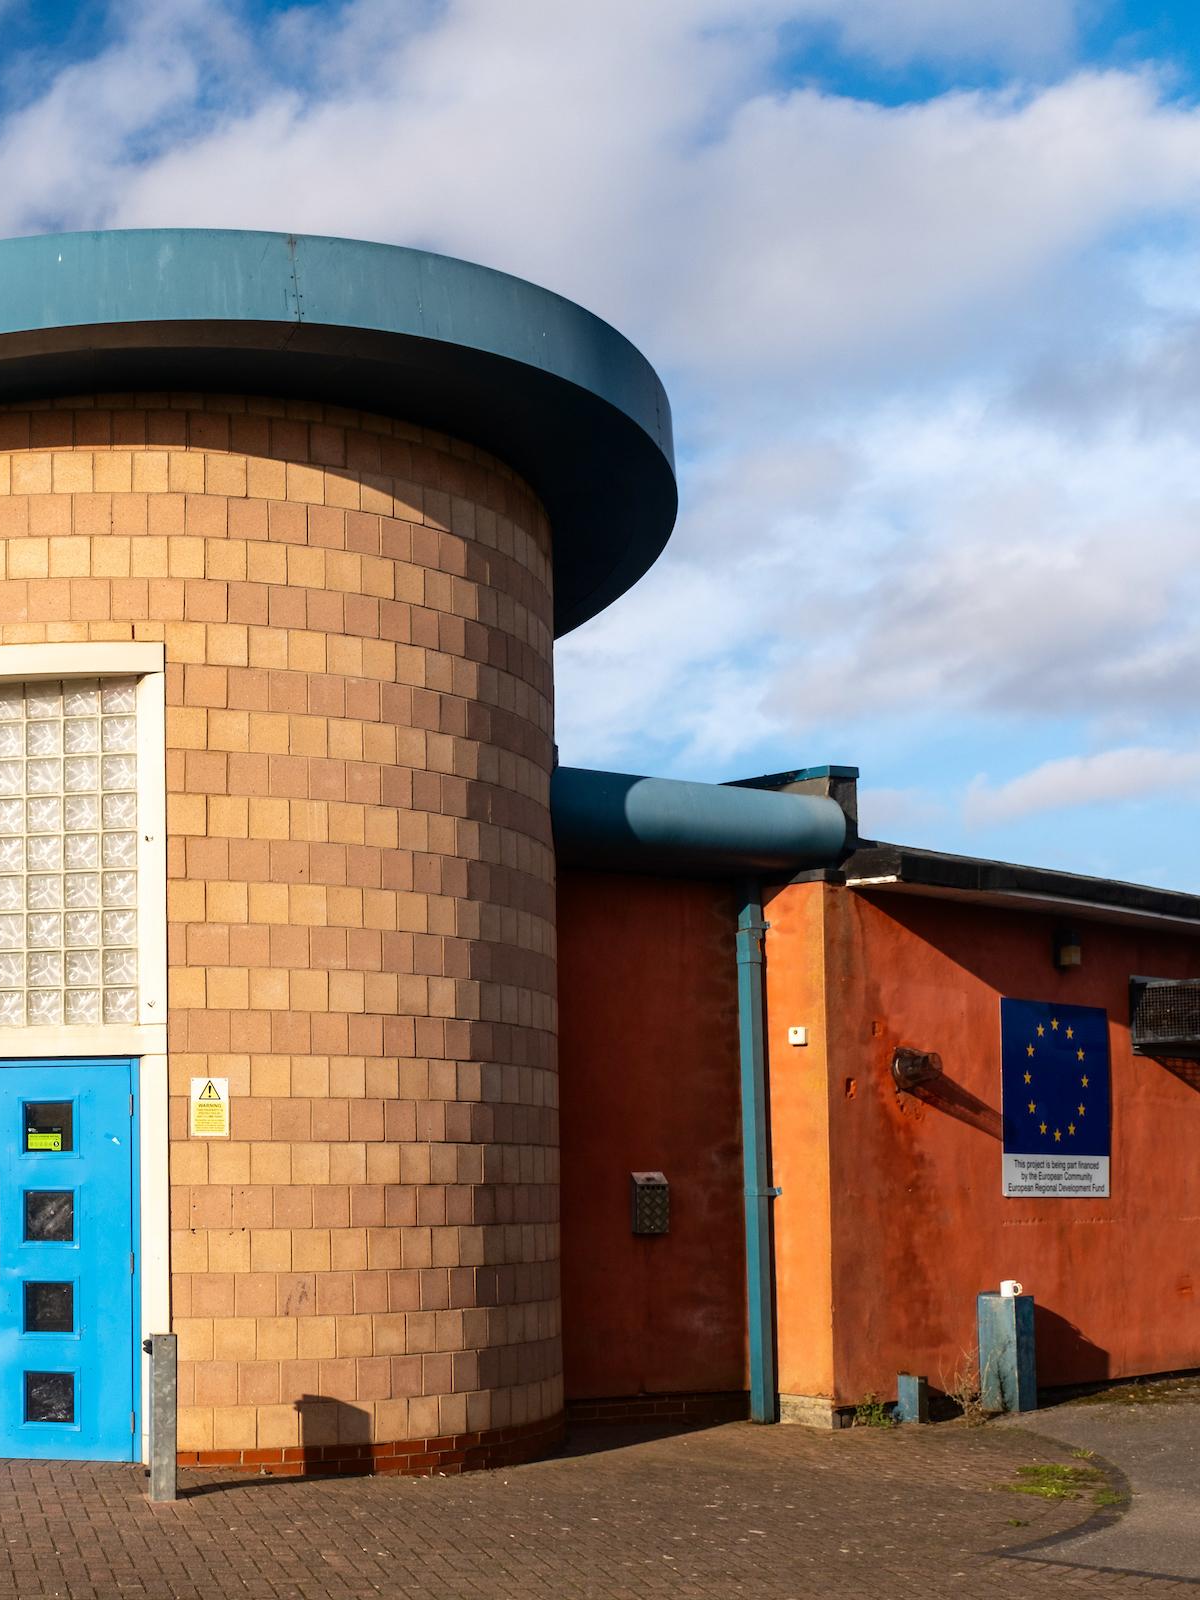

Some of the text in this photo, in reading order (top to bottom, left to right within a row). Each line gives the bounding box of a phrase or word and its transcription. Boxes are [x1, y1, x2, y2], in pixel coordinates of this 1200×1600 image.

[1014, 1159, 1099, 1171] This project is being part financed
[1021, 1172, 1092, 1183] by the European Community
[1008, 1183, 1105, 1194] European Regional Development Fund
